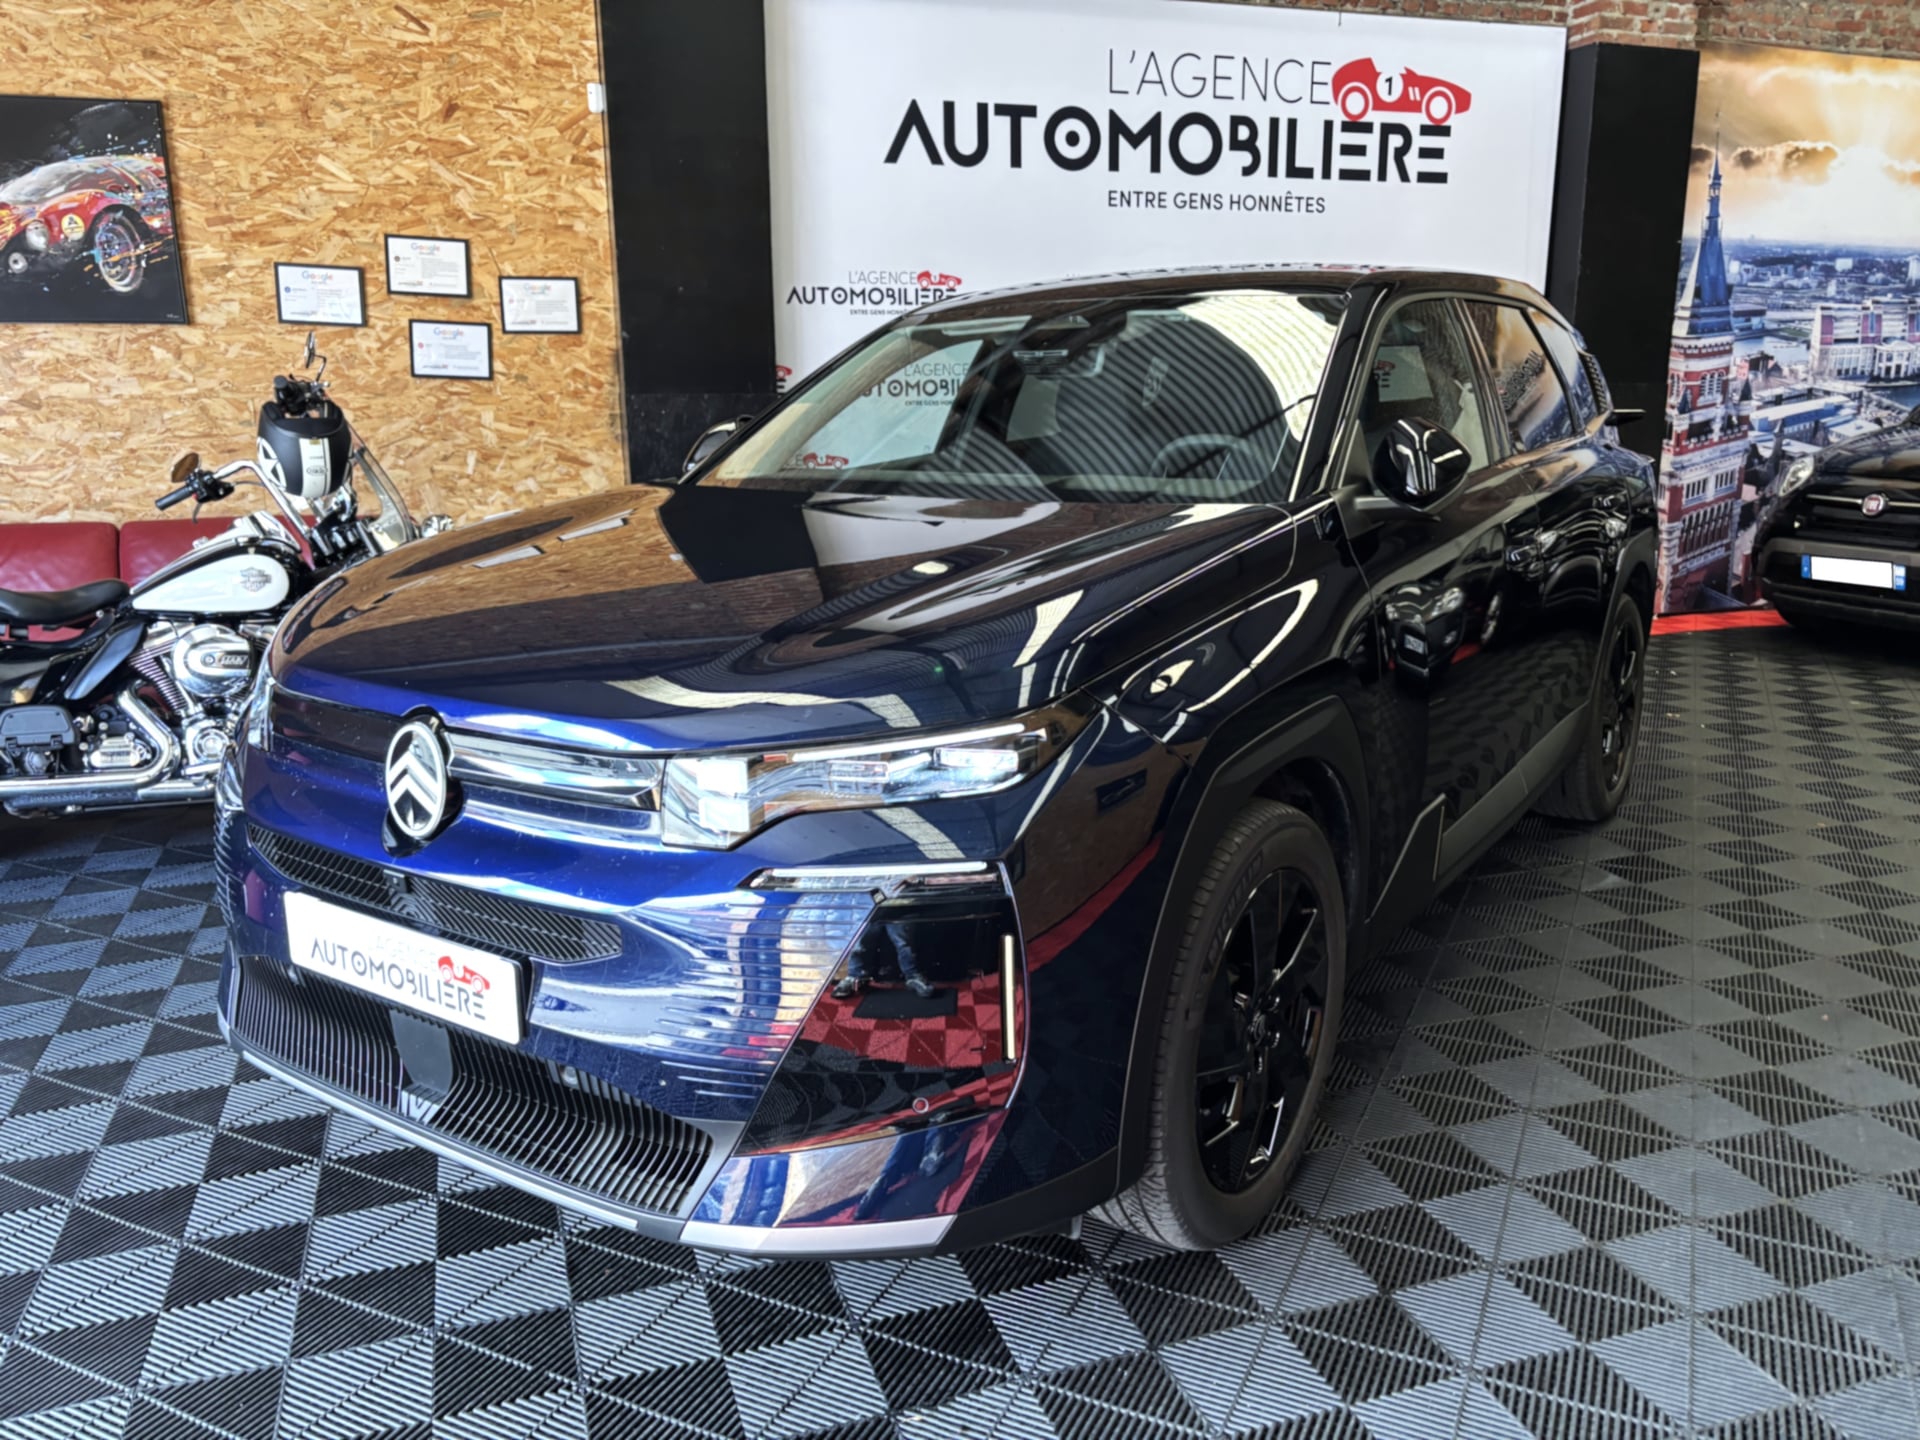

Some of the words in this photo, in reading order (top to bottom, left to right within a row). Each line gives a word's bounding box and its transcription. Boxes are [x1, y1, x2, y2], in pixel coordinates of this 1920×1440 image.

[1109, 48, 1331, 105] L'AGENCE
[1384, 75, 1394, 96] 1
[884, 99, 1451, 184] AUTOMOBILIERE
[1108, 190, 1168, 209] ENTRE
[1173, 192, 1224, 211] GENS
[1229, 191, 1326, 213] HONNÊTES
[849, 271, 917, 285] L'AGENCE
[311, 937, 486, 1021] AUTOMOBILIERE
